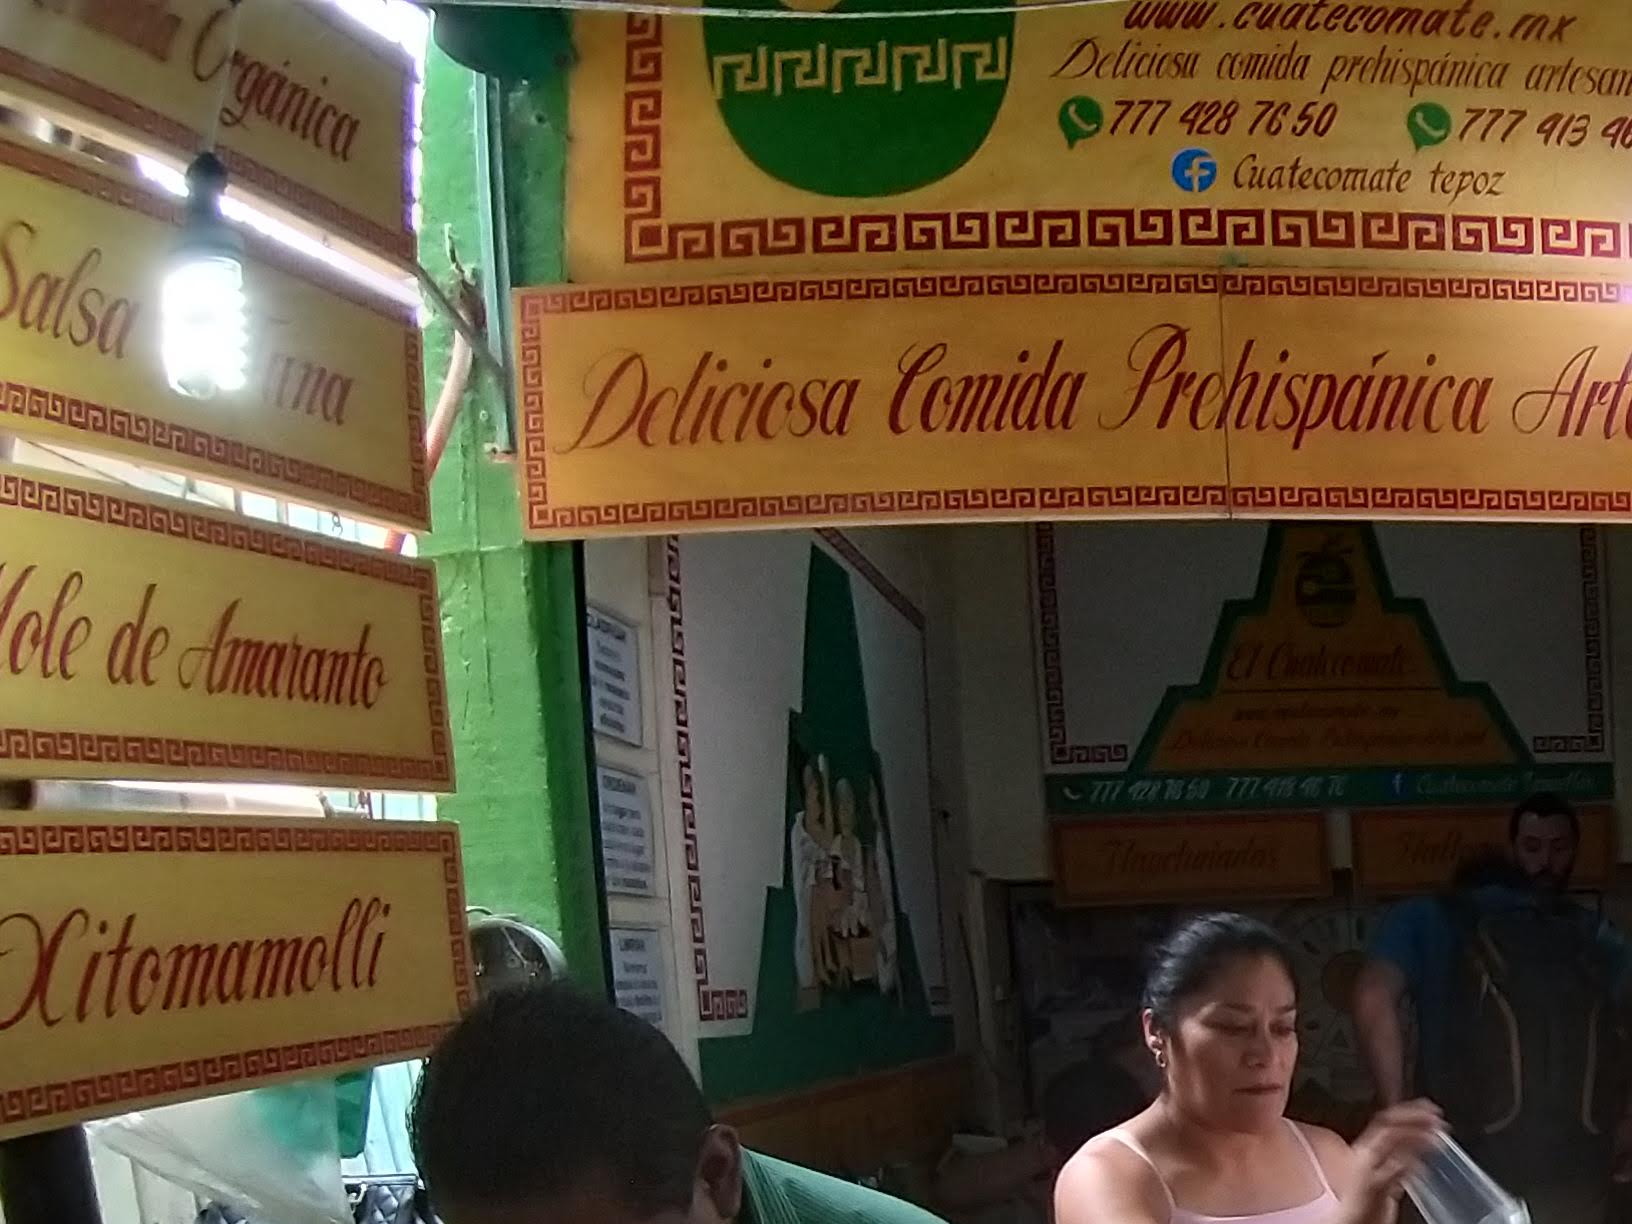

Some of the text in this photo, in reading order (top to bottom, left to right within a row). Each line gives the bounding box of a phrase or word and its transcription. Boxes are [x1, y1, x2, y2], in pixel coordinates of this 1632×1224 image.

[1123, 0, 1577, 43] www.cuatecomate.mx
[1049, 36, 1200, 80] Deliciosa
[1216, 40, 1312, 82] comida
[1109, 100, 1173, 136] 777
[1178, 100, 1240, 136] 428
[1458, 107, 1528, 143] 777
[1536, 111, 1592, 148] 413
[1232, 153, 1413, 194] Cuatecomate
[1428, 159, 1507, 207] tepoz
[0, 220, 140, 361] Salsa
[552, 347, 862, 456] Deliciosa
[887, 338, 1089, 435] Comida
[1097, 322, 1498, 452] Prehispánica
[106, 583, 172, 687] de
[178, 596, 390, 712] Amaranto
[0, 896, 393, 1031] Xitomamolli
